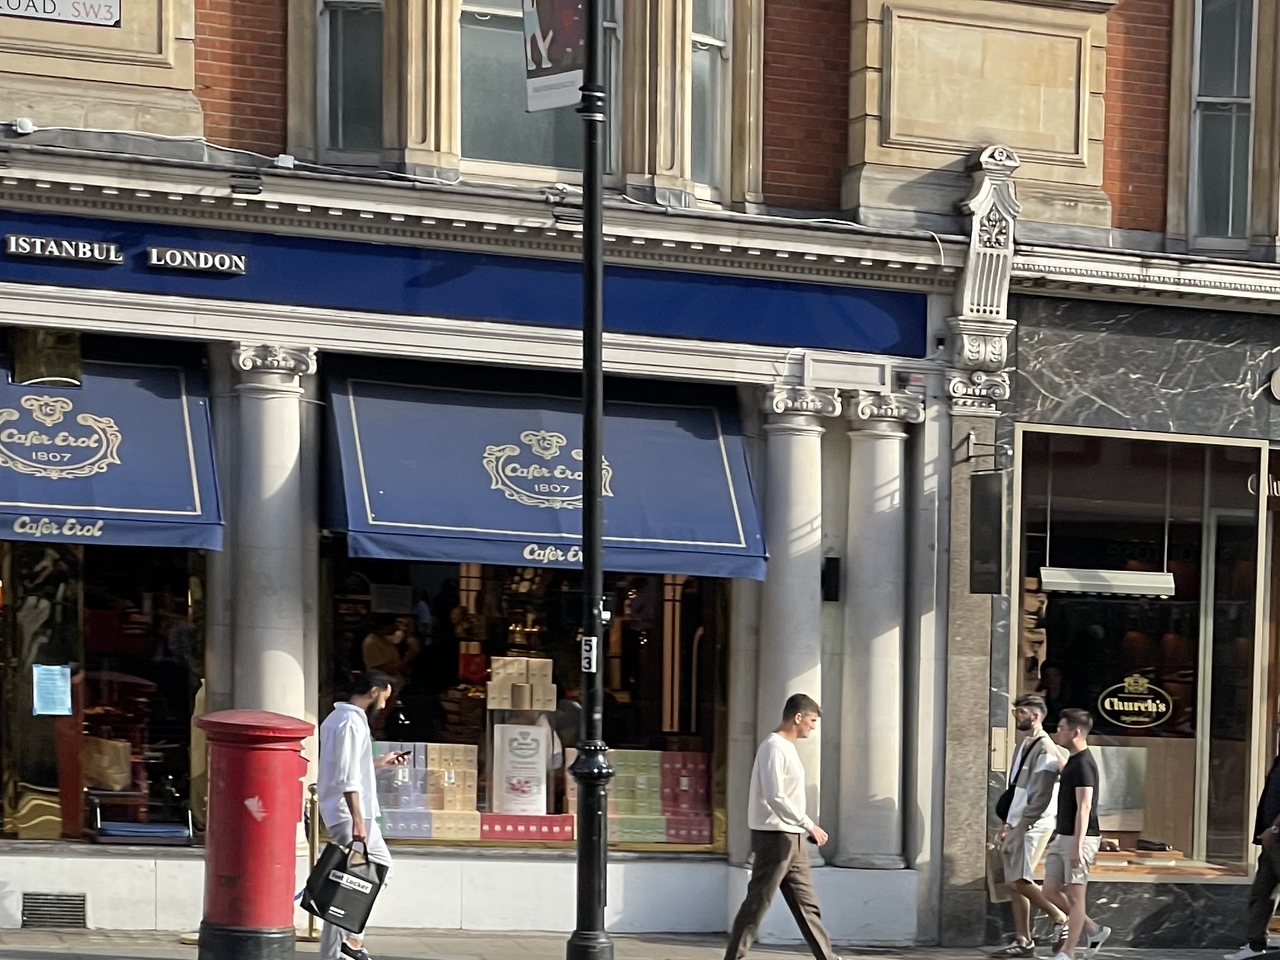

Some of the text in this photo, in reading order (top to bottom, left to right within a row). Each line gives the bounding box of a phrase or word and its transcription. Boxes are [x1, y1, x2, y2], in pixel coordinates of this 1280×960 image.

[9, 236, 246, 271] ISTANBUL LONDON
[54, 431, 100, 448] Erol
[32, 451, 72, 462] 1807
[553, 464, 583, 481] Ero
[534, 484, 570, 493] 1807
[62, 518, 104, 537] Erol
[1104, 697, 1167, 713] Church's
[345, 877, 370, 891] Locker
